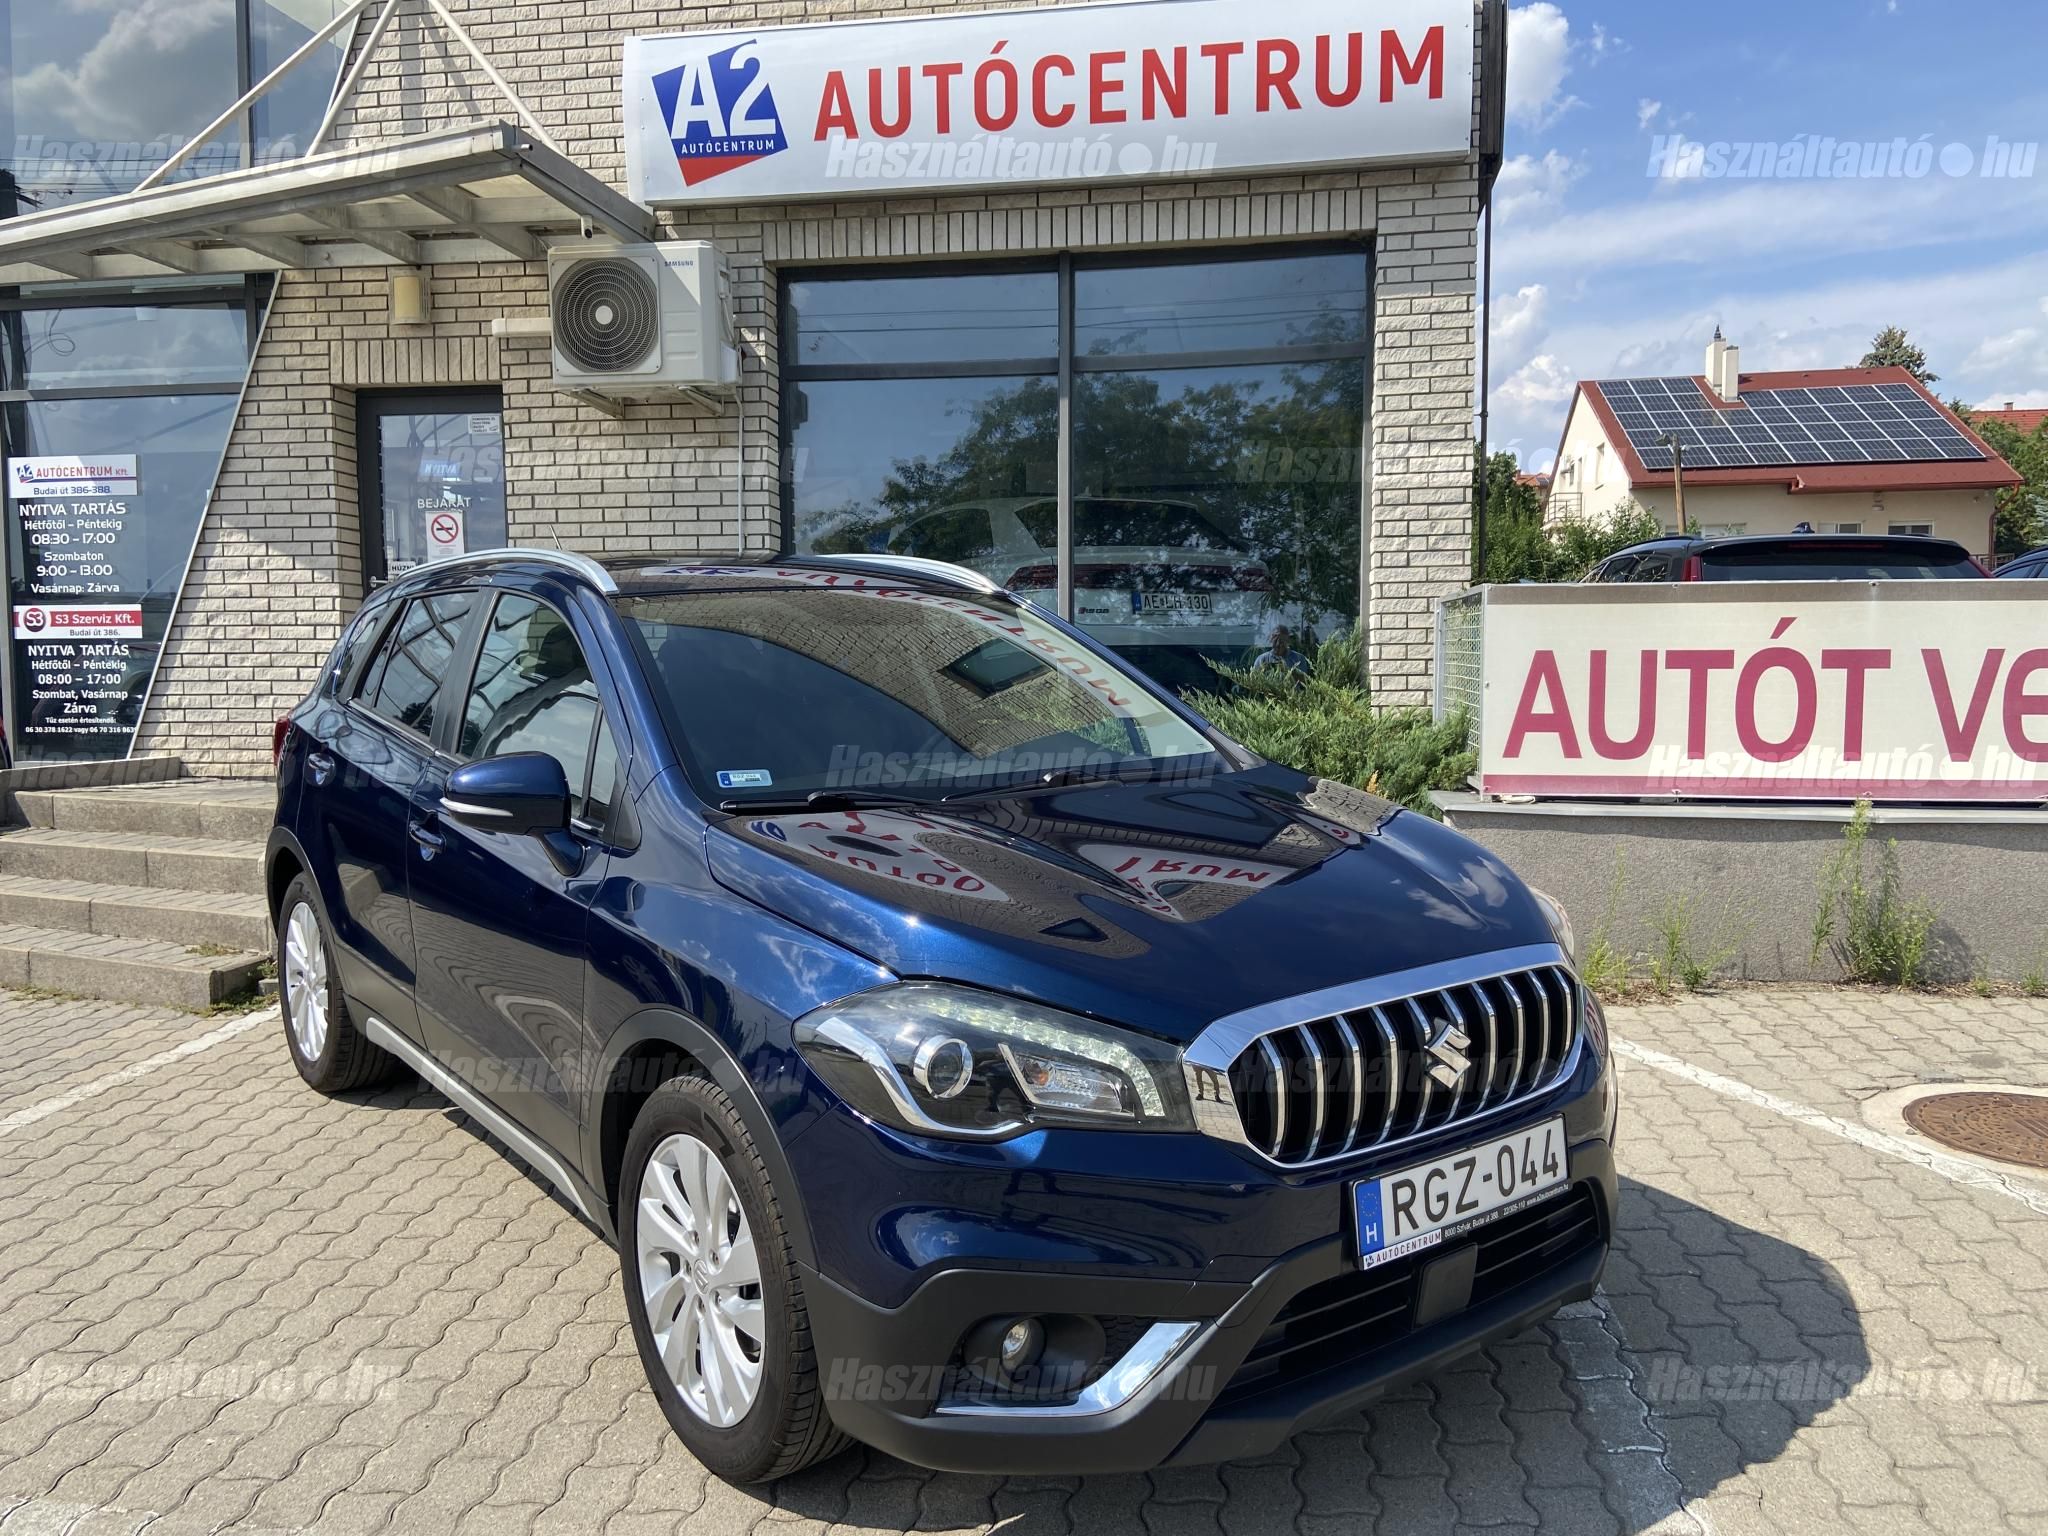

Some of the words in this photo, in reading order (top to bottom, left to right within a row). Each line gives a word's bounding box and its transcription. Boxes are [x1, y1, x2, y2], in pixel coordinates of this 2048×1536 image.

[813, 26, 1444, 141] AUTÓCENTRUM
[671, 43, 776, 138] A2
[681, 139, 775, 154] AUTÓCENTRUM
[36, 465, 112, 478] AUTÓCENTRUM
[34, 486, 58, 495] Budai
[71, 485, 111, 494] 386-388
[20, 504, 66, 516] NYITVA
[71, 500, 126, 515] TARTÁS
[24, 519, 66, 530] Hétfőtől
[76, 519, 122, 531] Péntekig
[32, 533, 70, 545] 08:30
[82, 532, 116, 544] 17:00
[44, 551, 104, 562] Szombaton
[36, 565, 67, 576] 9:00
[80, 564, 113, 576] 13:00
[31, 583, 85, 594] Vasárnap:
[87, 582, 120, 593] Zárva
[26, 611, 44, 627] S3
[55, 614, 69, 624] S3
[72, 614, 112, 624] Szerviz
[114, 613, 135, 624] Kft.
[28, 645, 75, 656] NYITVA
[80, 641, 129, 656] TARTÁS
[31, 660, 71, 670] Hétfőtől
[83, 660, 127, 670] Péntekig
[38, 674, 72, 684] 08:00
[87, 674, 121, 684] 17:00
[32, 690, 78, 700] Szombat,
[80, 689, 128, 700] Vasárnap
[1502, 617, 1892, 763] AUTÓT
[63, 702, 97, 713] Zárva
[1391, 1128, 1559, 1237] RGZ-044
[1365, 1222, 1378, 1245] H
[1376, 1232, 1441, 1263] AUTÓCENTRUM
